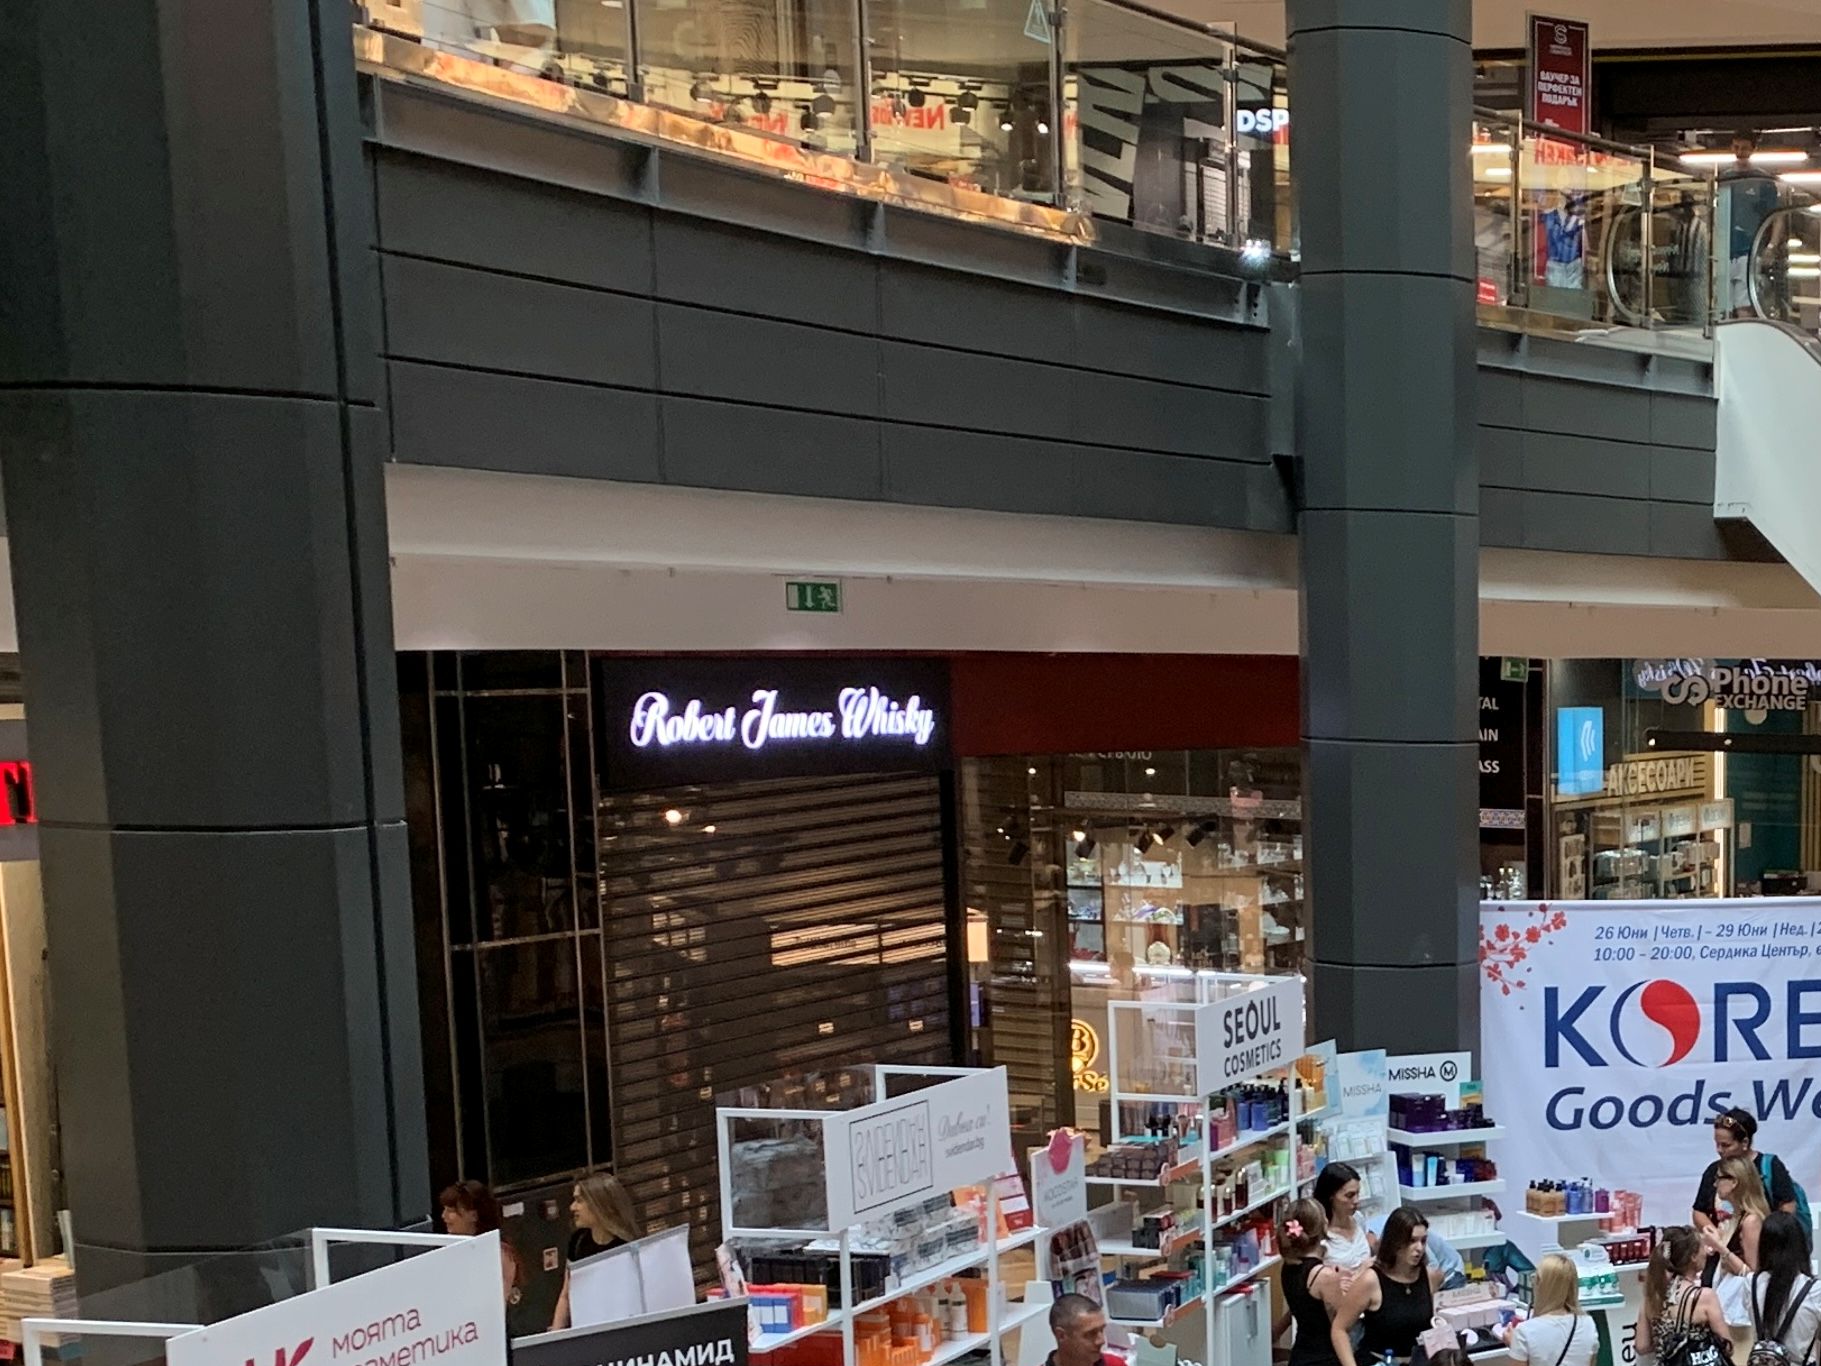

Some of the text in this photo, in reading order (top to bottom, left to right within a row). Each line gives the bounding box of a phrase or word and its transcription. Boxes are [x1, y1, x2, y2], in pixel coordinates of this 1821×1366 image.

[1714, 667, 1808, 695] Phone
[629, 686, 935, 749] Robert James Whisky
[1714, 695, 1806, 711] EXCHANGE
[1607, 756, 1695, 796] АКСЕСОАРИ
[1594, 926, 1614, 941] 26
[1617, 925, 1648, 940] Юни
[1716, 924, 1734, 938] 29
[1737, 923, 1768, 938] Юни
[1593, 947, 1635, 962] 10:00
[1650, 946, 1696, 961] 20:00,
[1700, 945, 1758, 962] Сердика
[1761, 942, 1813, 959] Център,
[1223, 996, 1281, 1049] SEOUL
[1224, 1038, 1282, 1078] COSMETICS
[1388, 1066, 1435, 1081] MISSHA
[1343, 1082, 1382, 1097] MISSHA
[1545, 1079, 1731, 1131] Goods
[331, 1308, 422, 1359] моята
